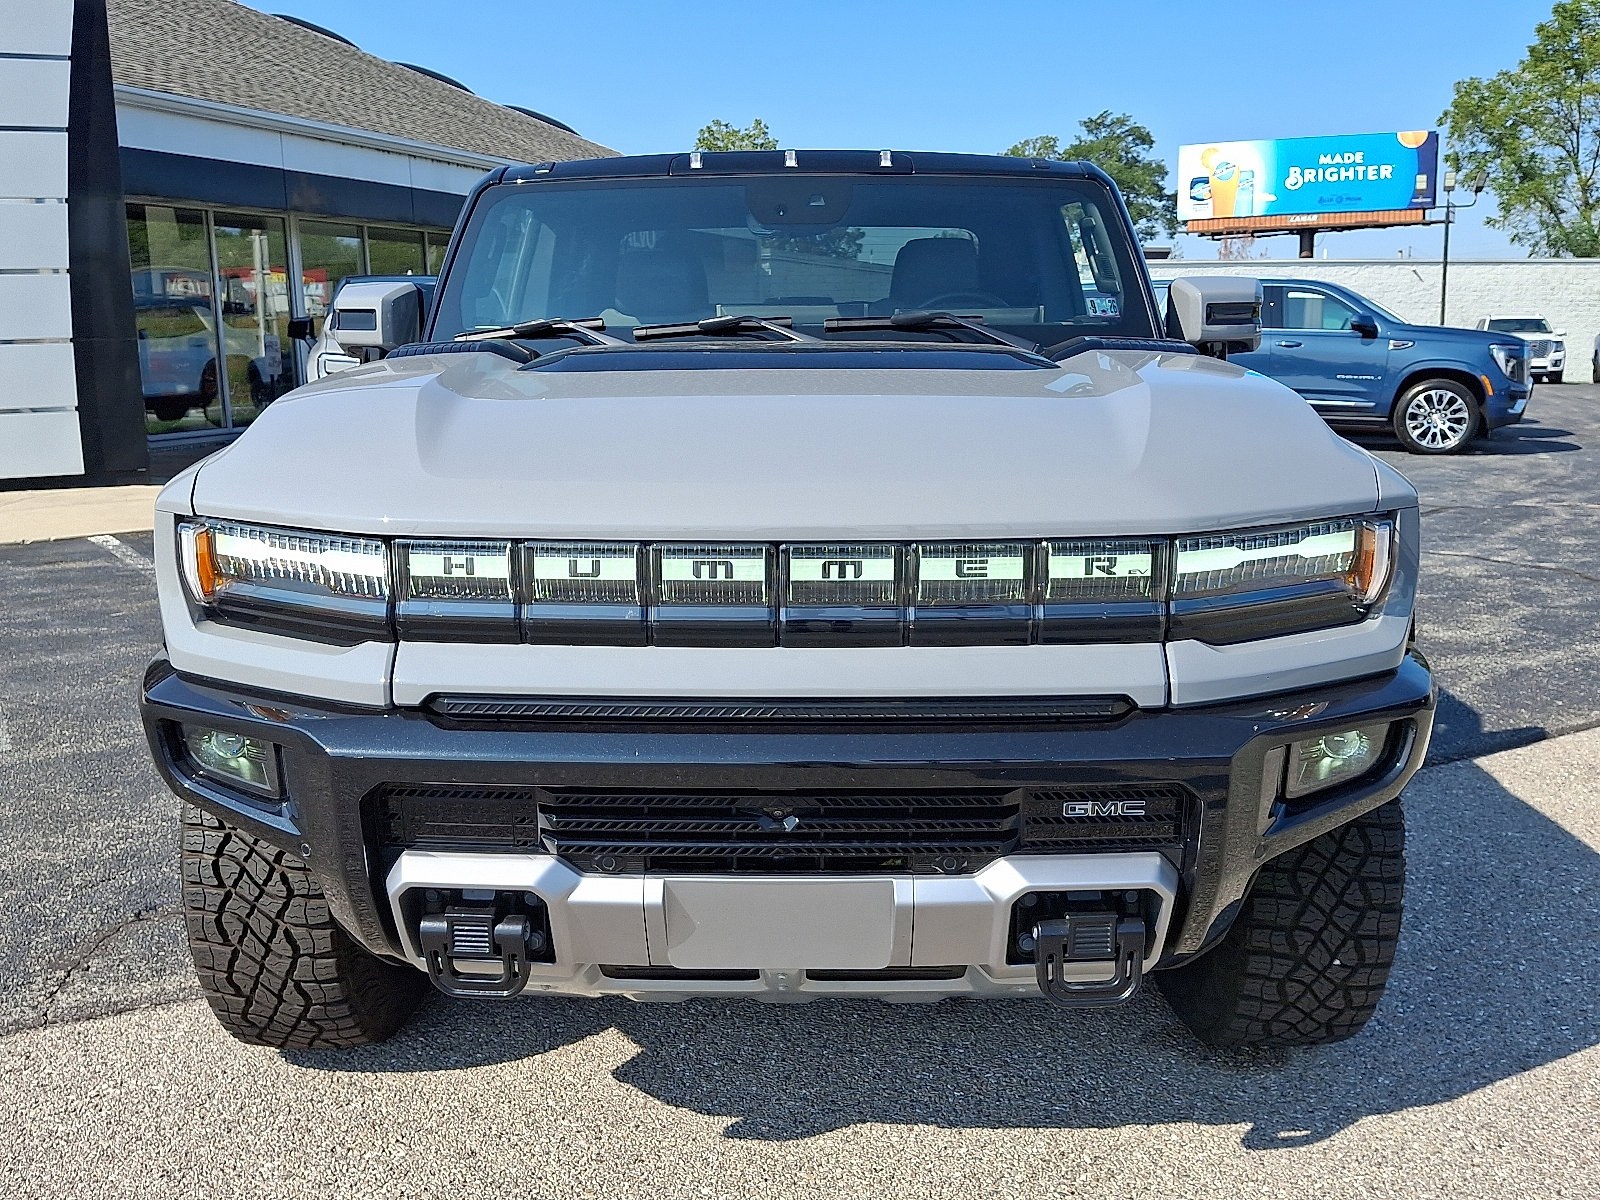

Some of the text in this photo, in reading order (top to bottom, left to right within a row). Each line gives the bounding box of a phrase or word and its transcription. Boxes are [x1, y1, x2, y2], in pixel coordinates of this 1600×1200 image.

[1318, 151, 1364, 164] MADE
[1284, 164, 1393, 191] BRIGHTER
[1090, 299, 1098, 314] 9
[1063, 800, 1146, 817] GMC
